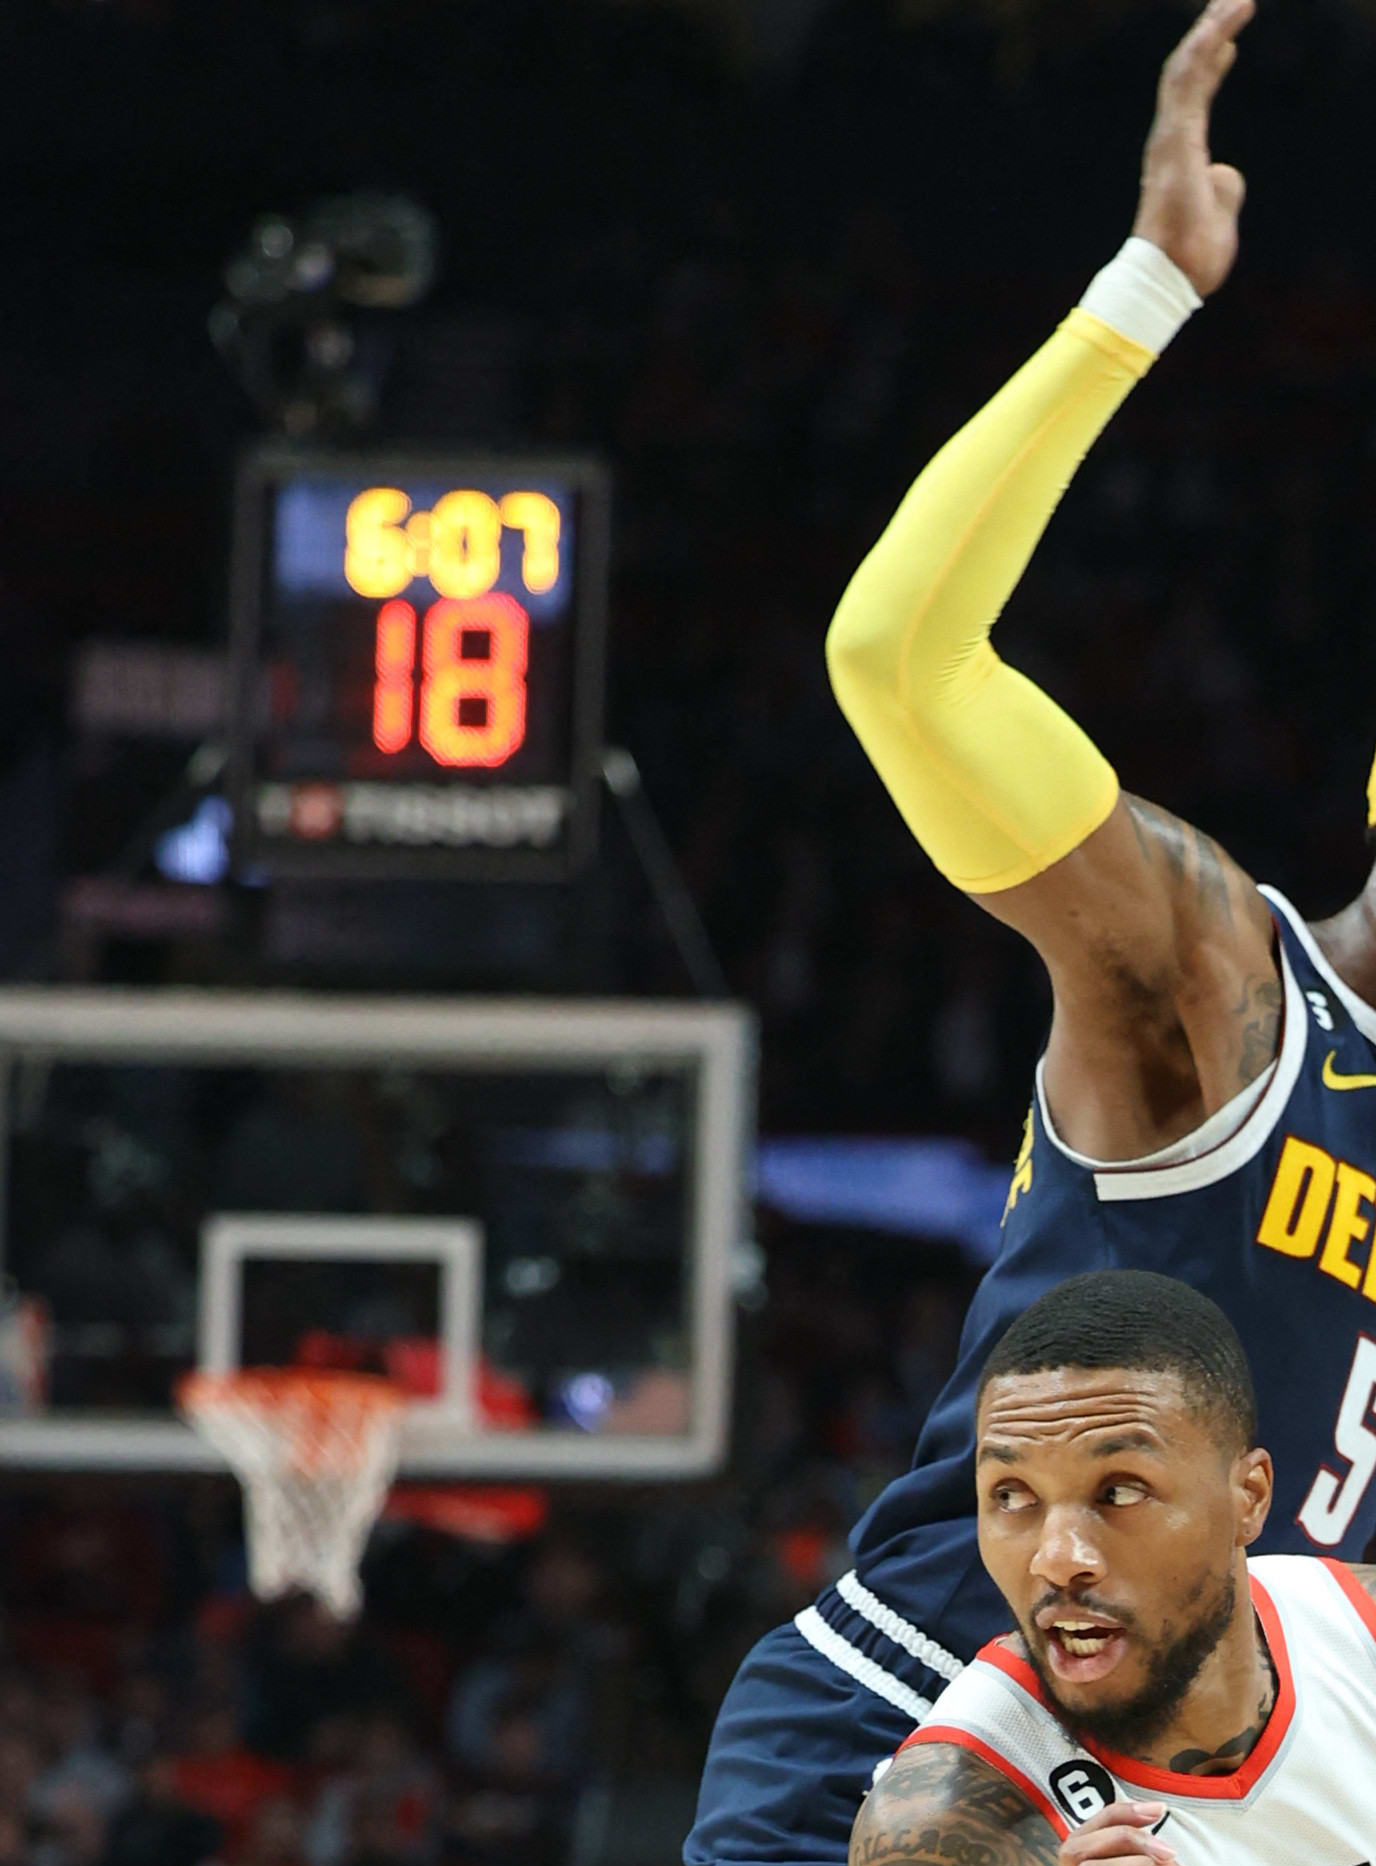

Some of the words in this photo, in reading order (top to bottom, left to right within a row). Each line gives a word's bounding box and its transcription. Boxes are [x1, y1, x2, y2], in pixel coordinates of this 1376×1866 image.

[345, 487, 560, 599] 6:07
[373, 592, 529, 767] 18
[1057, 1769, 1105, 1821] 6
